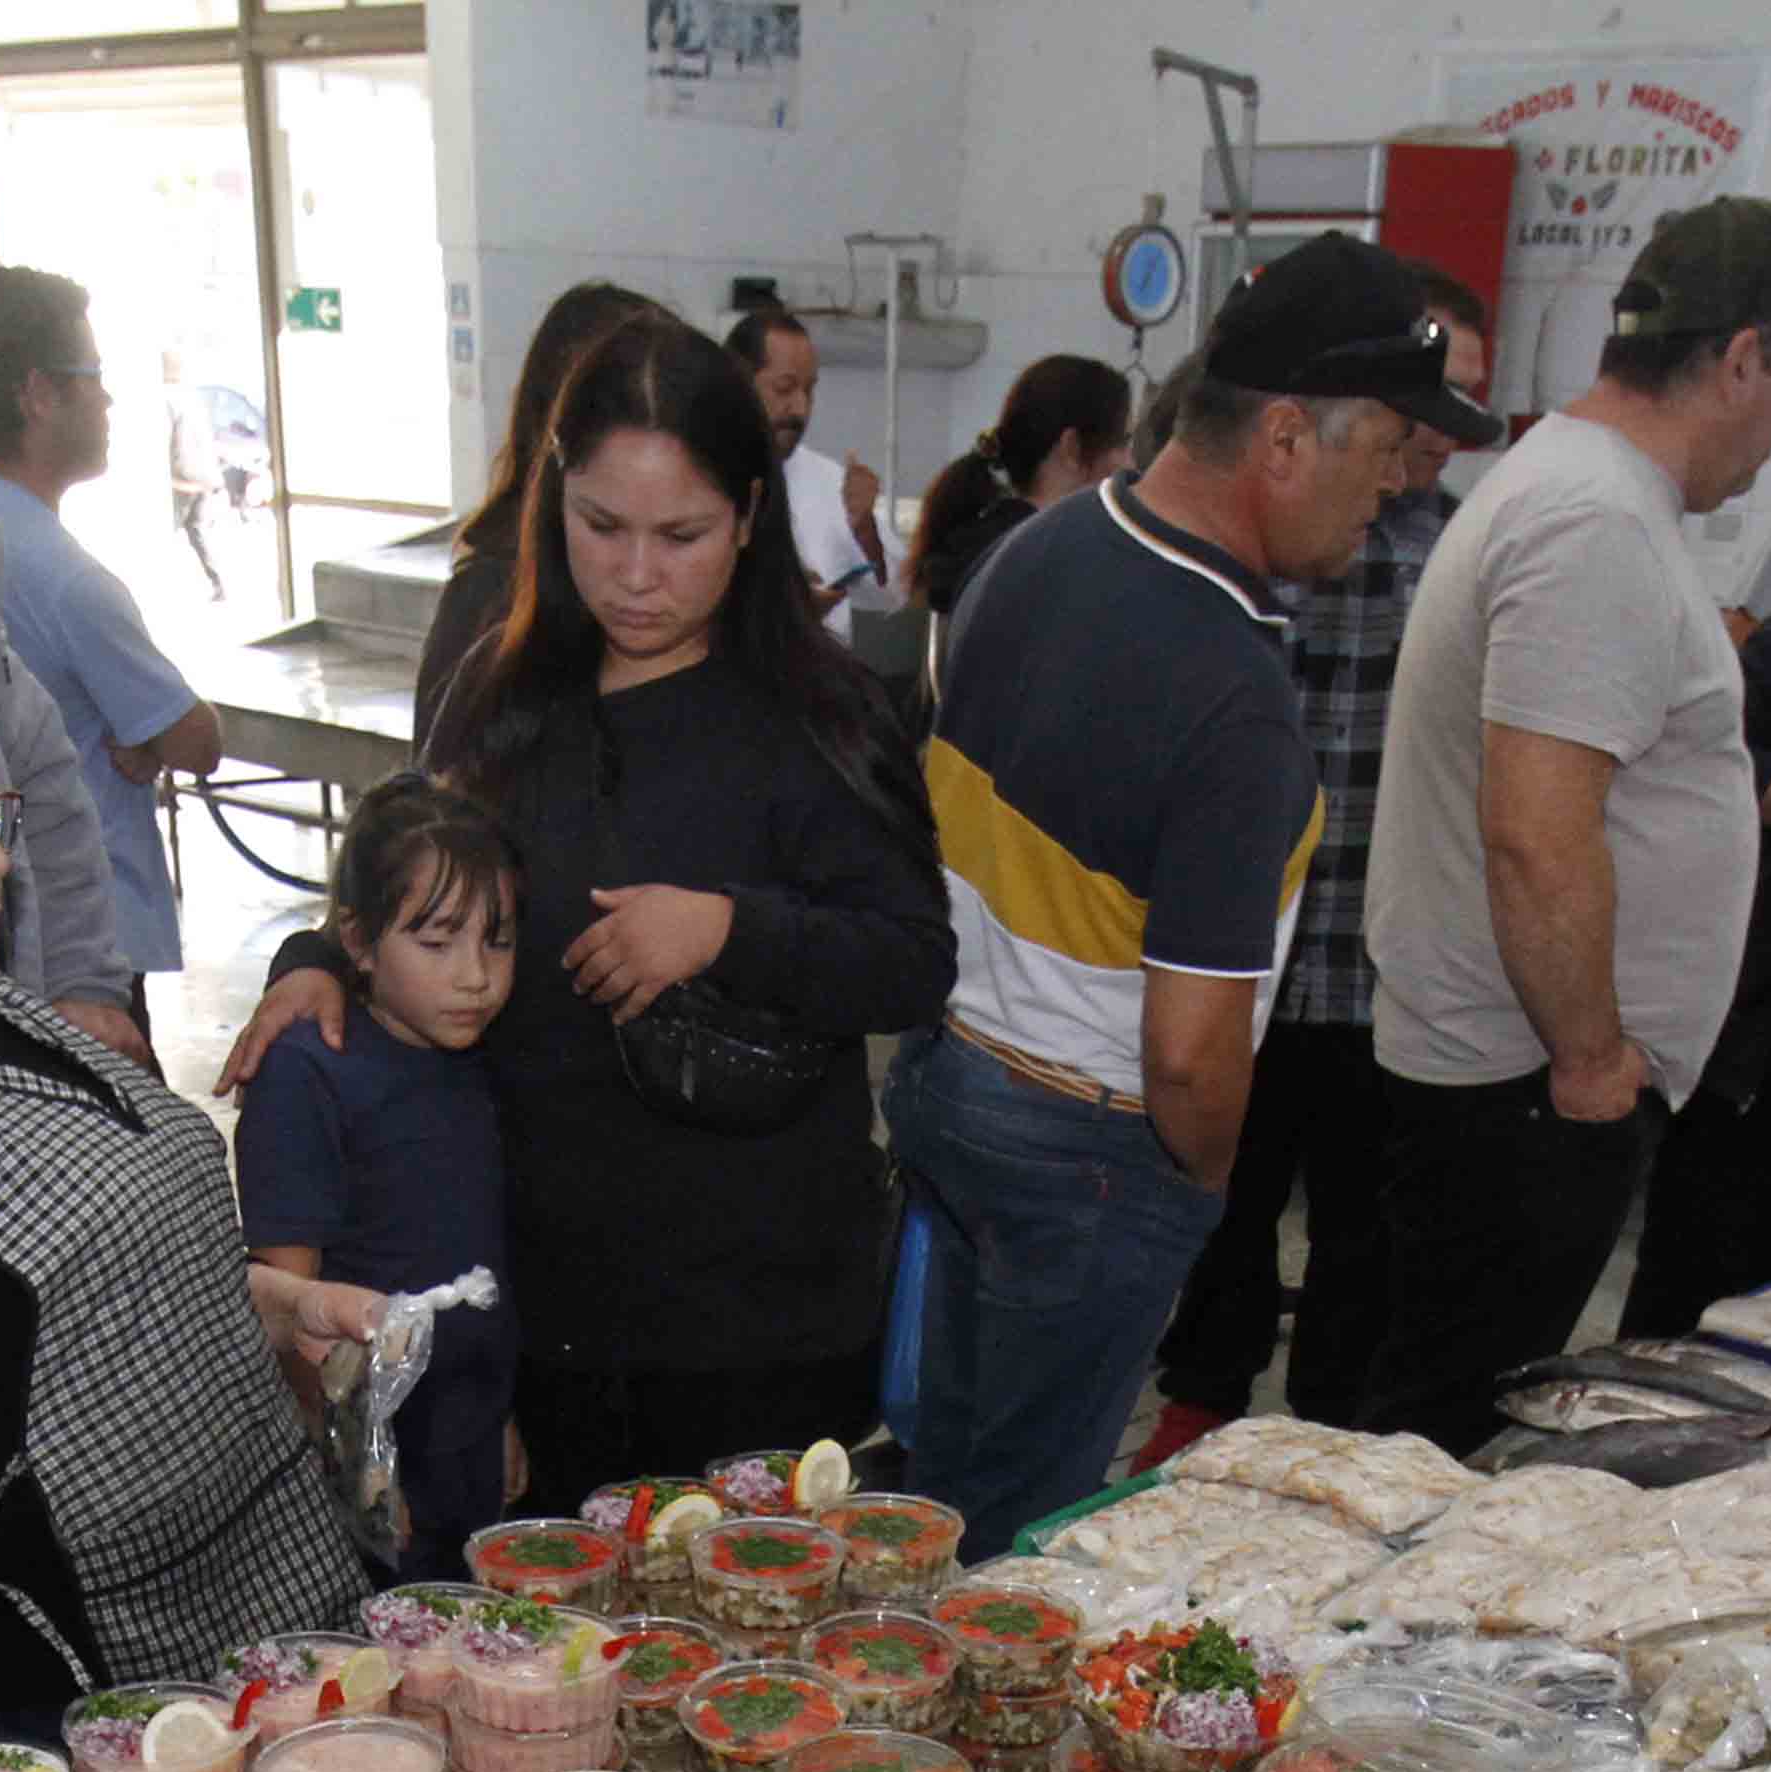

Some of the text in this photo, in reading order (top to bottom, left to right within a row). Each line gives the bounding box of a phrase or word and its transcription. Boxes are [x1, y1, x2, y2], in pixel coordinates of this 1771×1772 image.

[1597, 80, 1611, 109] Y
[1628, 83, 1741, 152] MARISCOS
[1564, 145, 1698, 176] FLORITA
[1518, 224, 1581, 247] LOCAL
